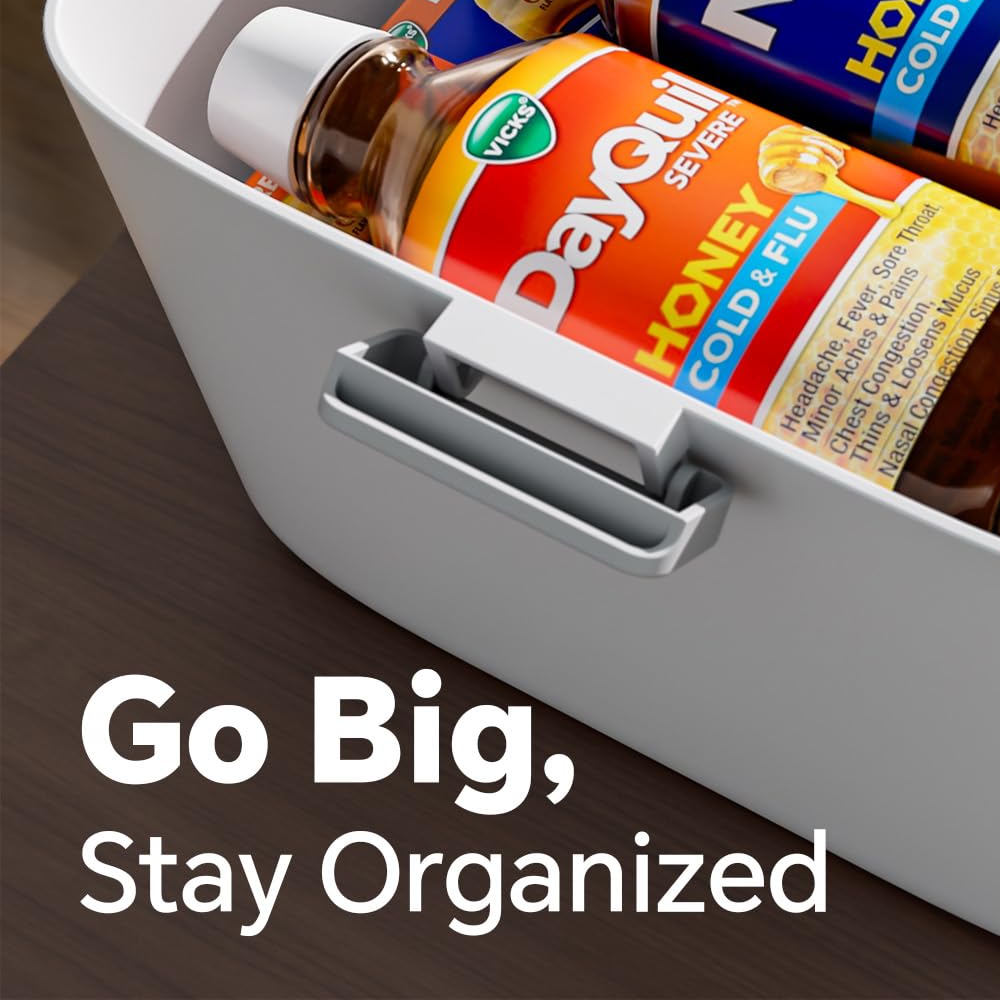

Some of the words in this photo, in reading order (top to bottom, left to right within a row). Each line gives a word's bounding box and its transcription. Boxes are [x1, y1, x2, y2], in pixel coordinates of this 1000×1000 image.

[897, 4, 960, 94] COLD
[494, 71, 731, 333] DayQuil
[663, 110, 745, 190] SEVERE
[633, 182, 774, 378] HONEY
[751, 268, 778, 287] &
[762, 205, 818, 265] FLU
[689, 288, 760, 391] COLD
[780, 337, 849, 433] Headache,
[837, 284, 883, 332] Fever,
[872, 244, 907, 279] Sore
[897, 203, 943, 243] Throat,
[802, 385, 842, 443] Minor
[842, 328, 878, 384] Aches
[870, 312, 887, 326] &
[885, 265, 919, 309] Pains
[830, 399, 871, 455] Chest
[862, 300, 936, 396] Congestion,
[850, 409, 891, 465] Thins
[882, 392, 901, 408] &
[900, 319, 946, 391] Loosens
[937, 266, 981, 318] Mucus
[878, 421, 919, 479] Nasal
[910, 326, 981, 421] Congestion,
